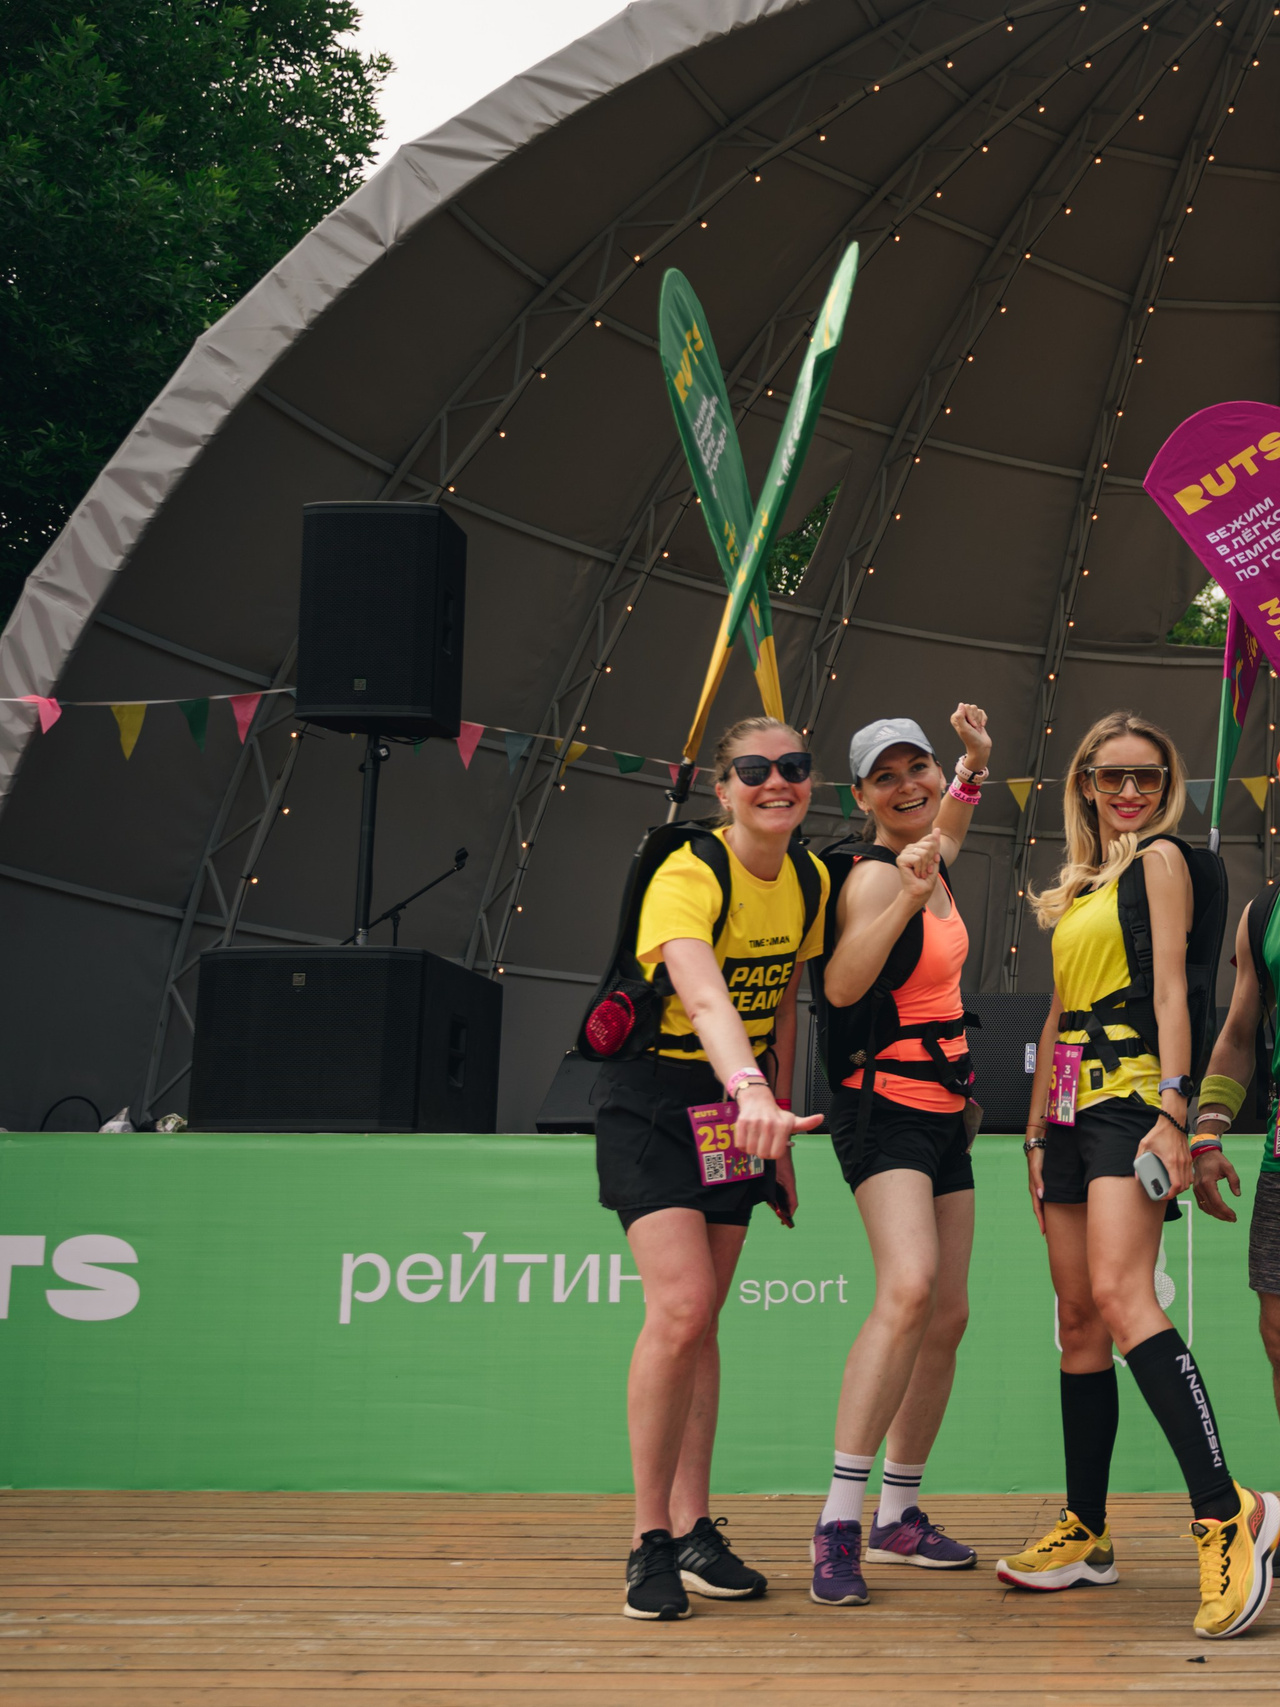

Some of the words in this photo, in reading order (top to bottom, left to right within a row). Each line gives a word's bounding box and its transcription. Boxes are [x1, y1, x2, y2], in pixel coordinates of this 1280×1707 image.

[1205, 496, 1274, 544] БЕЖИМ
[1216, 543, 1230, 557] В
[1235, 564, 1260, 582] ПО
[729, 961, 794, 988] PACE
[728, 986, 785, 1012] TEAM
[338, 1231, 648, 1325] рейтин
[739, 1274, 848, 1311] sport
[1186, 1373, 1223, 1468] NORDSKI
